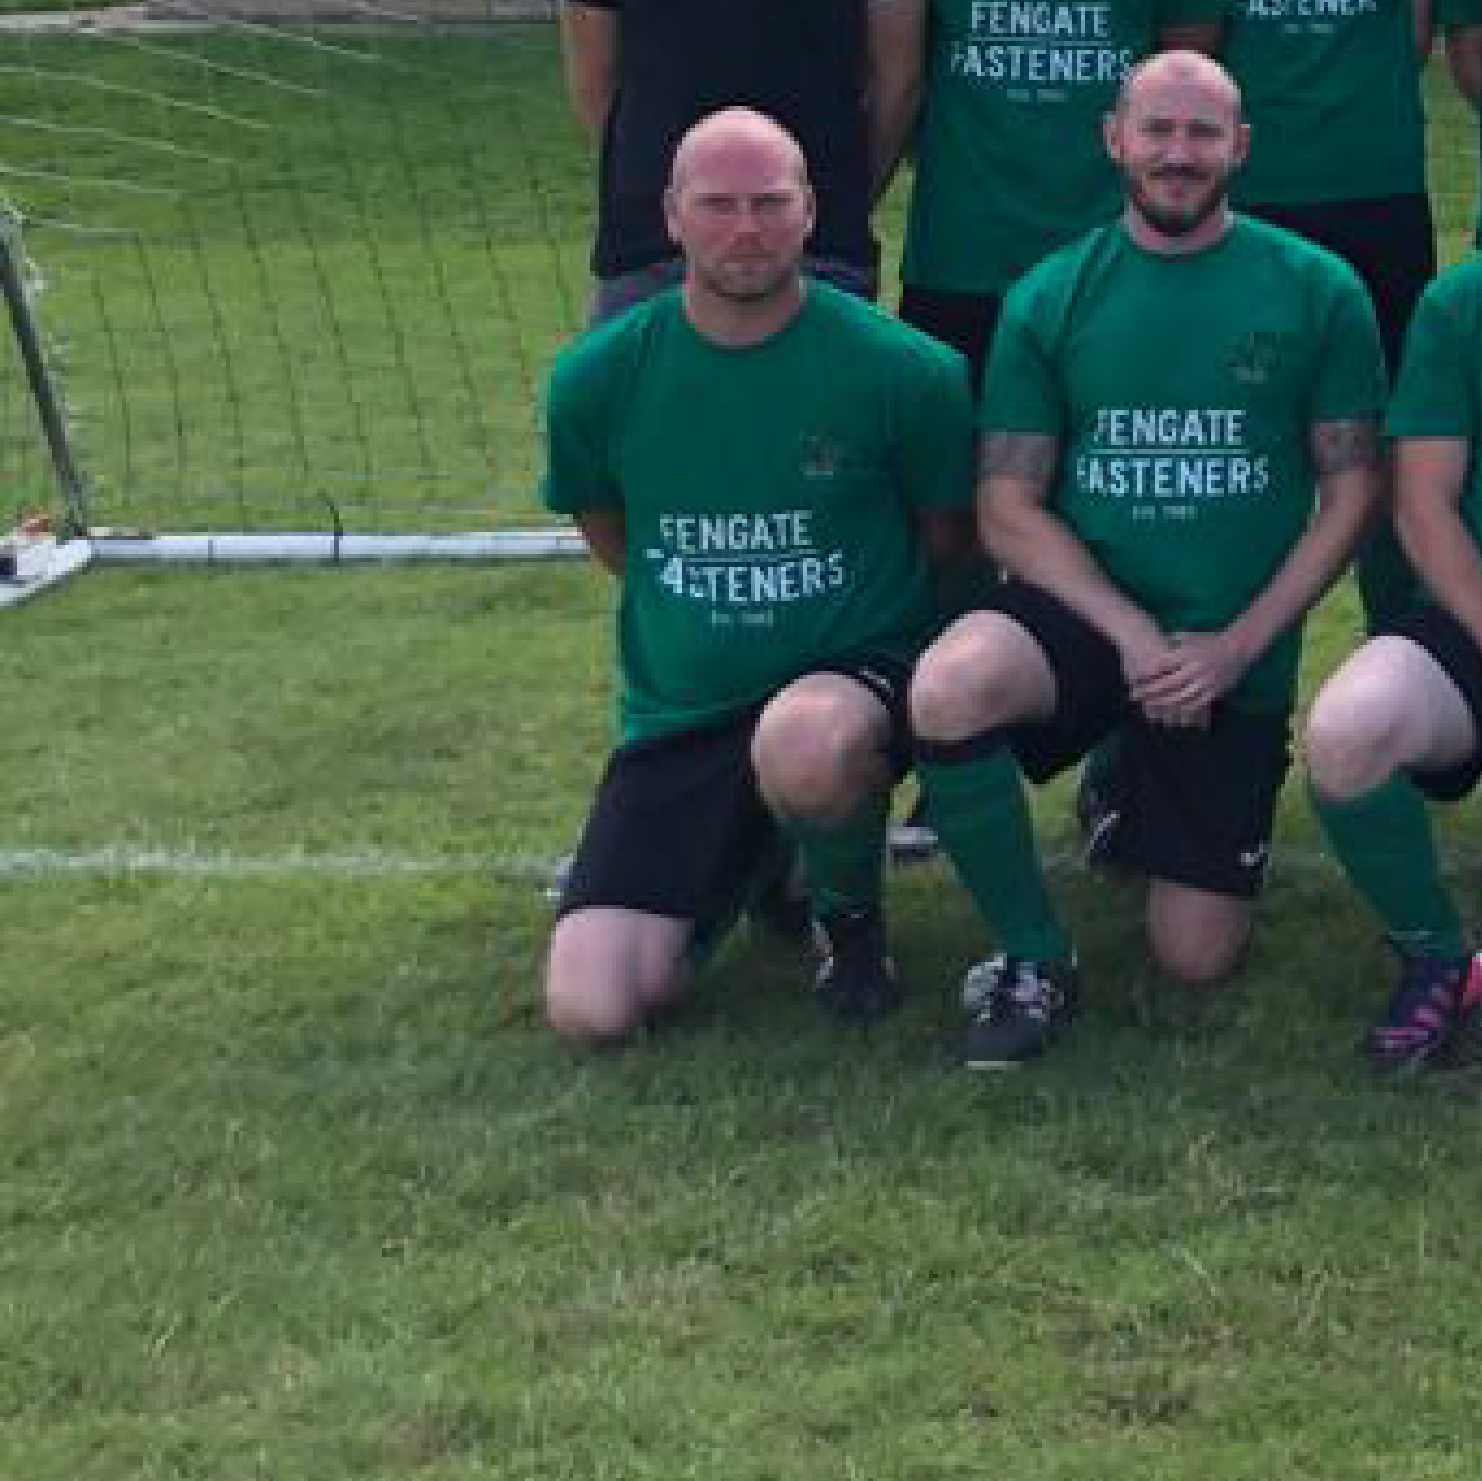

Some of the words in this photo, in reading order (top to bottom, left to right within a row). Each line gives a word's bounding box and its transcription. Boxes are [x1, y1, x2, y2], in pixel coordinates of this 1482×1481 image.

[971, 2, 1111, 37] FENGATE
[1094, 410, 1247, 446] FENGATE
[1077, 455, 1268, 497] FASTENERS
[660, 510, 813, 549] FENGATE
